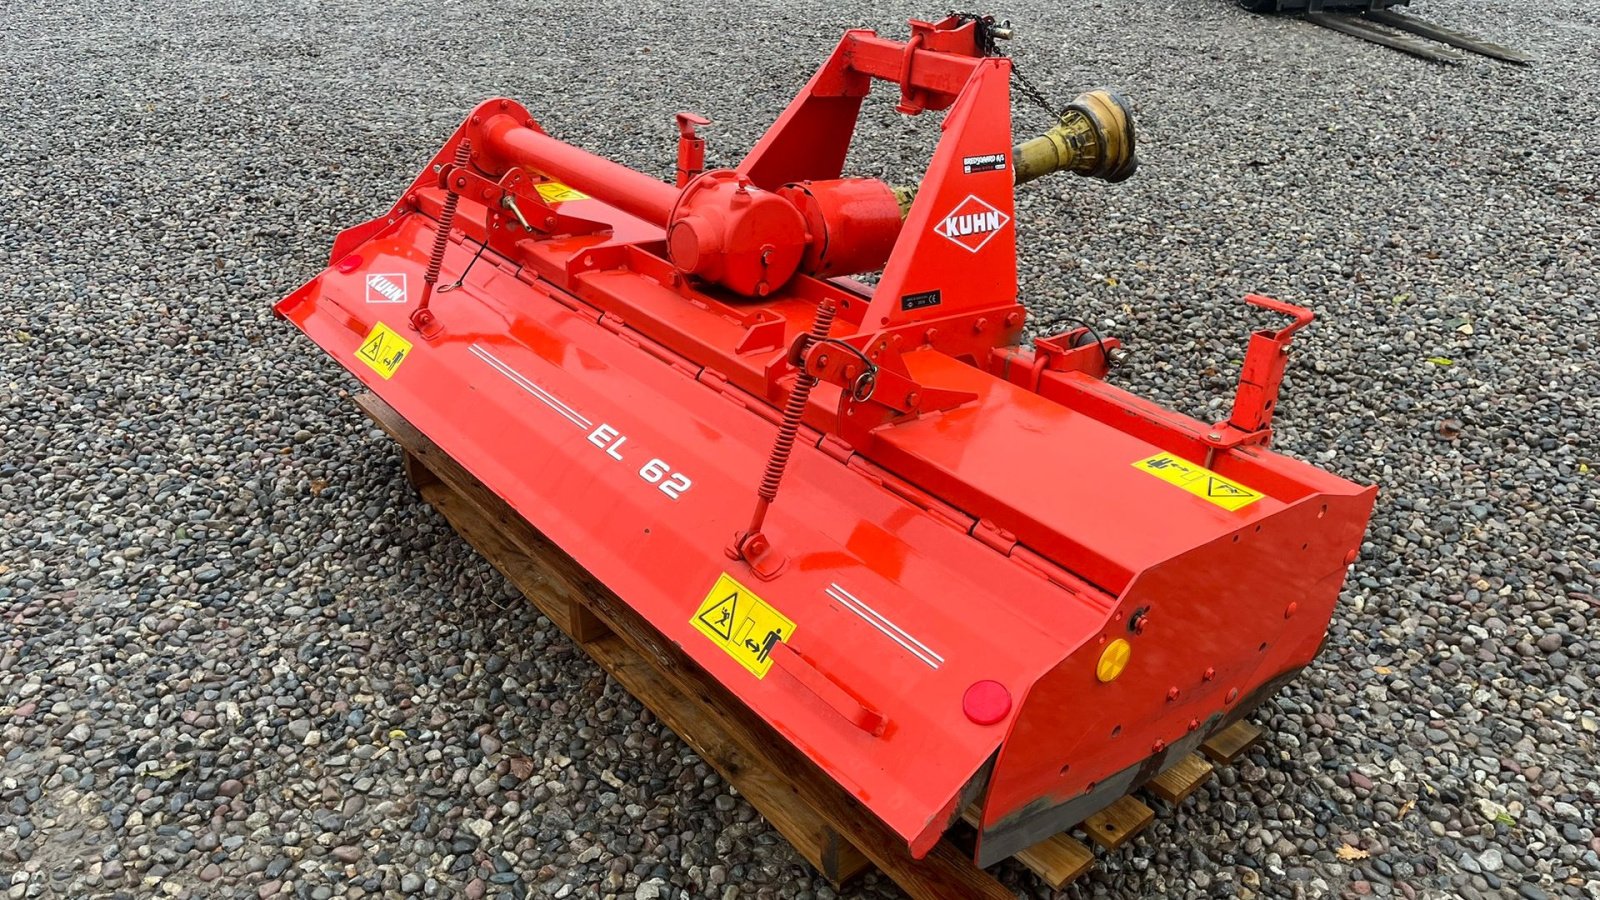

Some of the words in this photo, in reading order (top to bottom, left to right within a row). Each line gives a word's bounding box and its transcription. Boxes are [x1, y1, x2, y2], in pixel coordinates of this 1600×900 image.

[945, 210, 1000, 237] KUHN
[368, 274, 405, 302] KUHN
[586, 423, 627, 461] EL
[638, 458, 692, 500] 62
